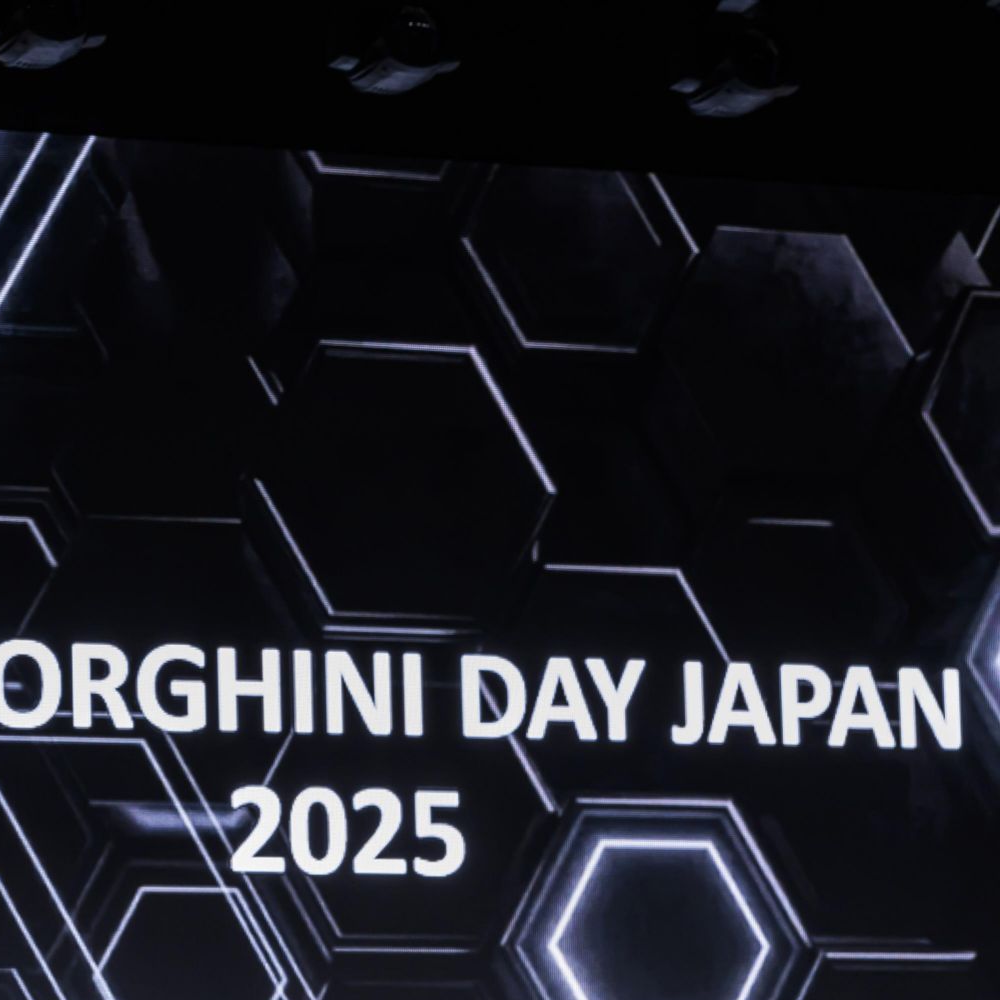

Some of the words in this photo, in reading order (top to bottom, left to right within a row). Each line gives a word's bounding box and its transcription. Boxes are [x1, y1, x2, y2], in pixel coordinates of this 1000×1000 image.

[461, 654, 647, 742] DAY
[670, 660, 962, 750] JAPAN
[230, 785, 466, 878] 2025
